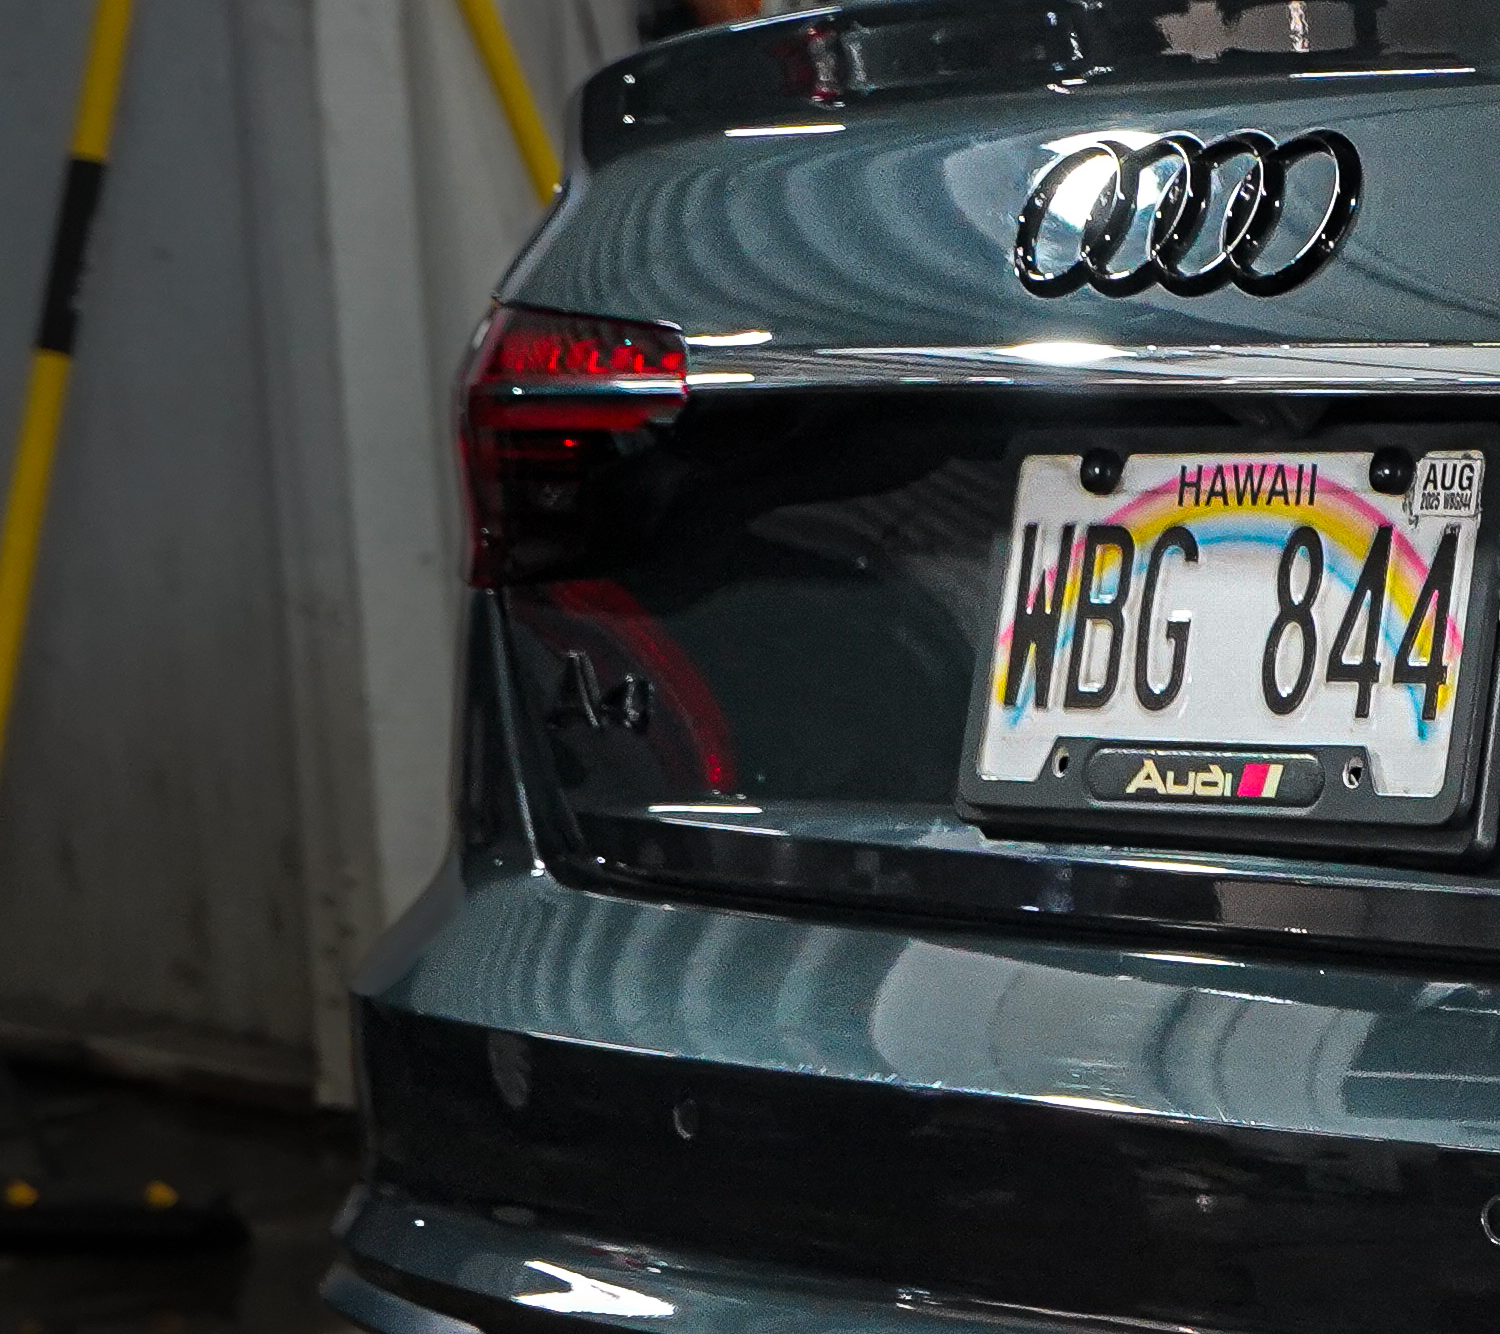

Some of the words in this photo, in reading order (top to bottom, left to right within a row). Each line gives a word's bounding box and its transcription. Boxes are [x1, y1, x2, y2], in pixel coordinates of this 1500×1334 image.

[1177, 464, 1317, 507] HAWAII
[1422, 463, 1476, 491] AUG
[1003, 521, 1199, 711] WBG
[1262, 522, 1459, 722] 844
[1125, 759, 1233, 797] Audi
